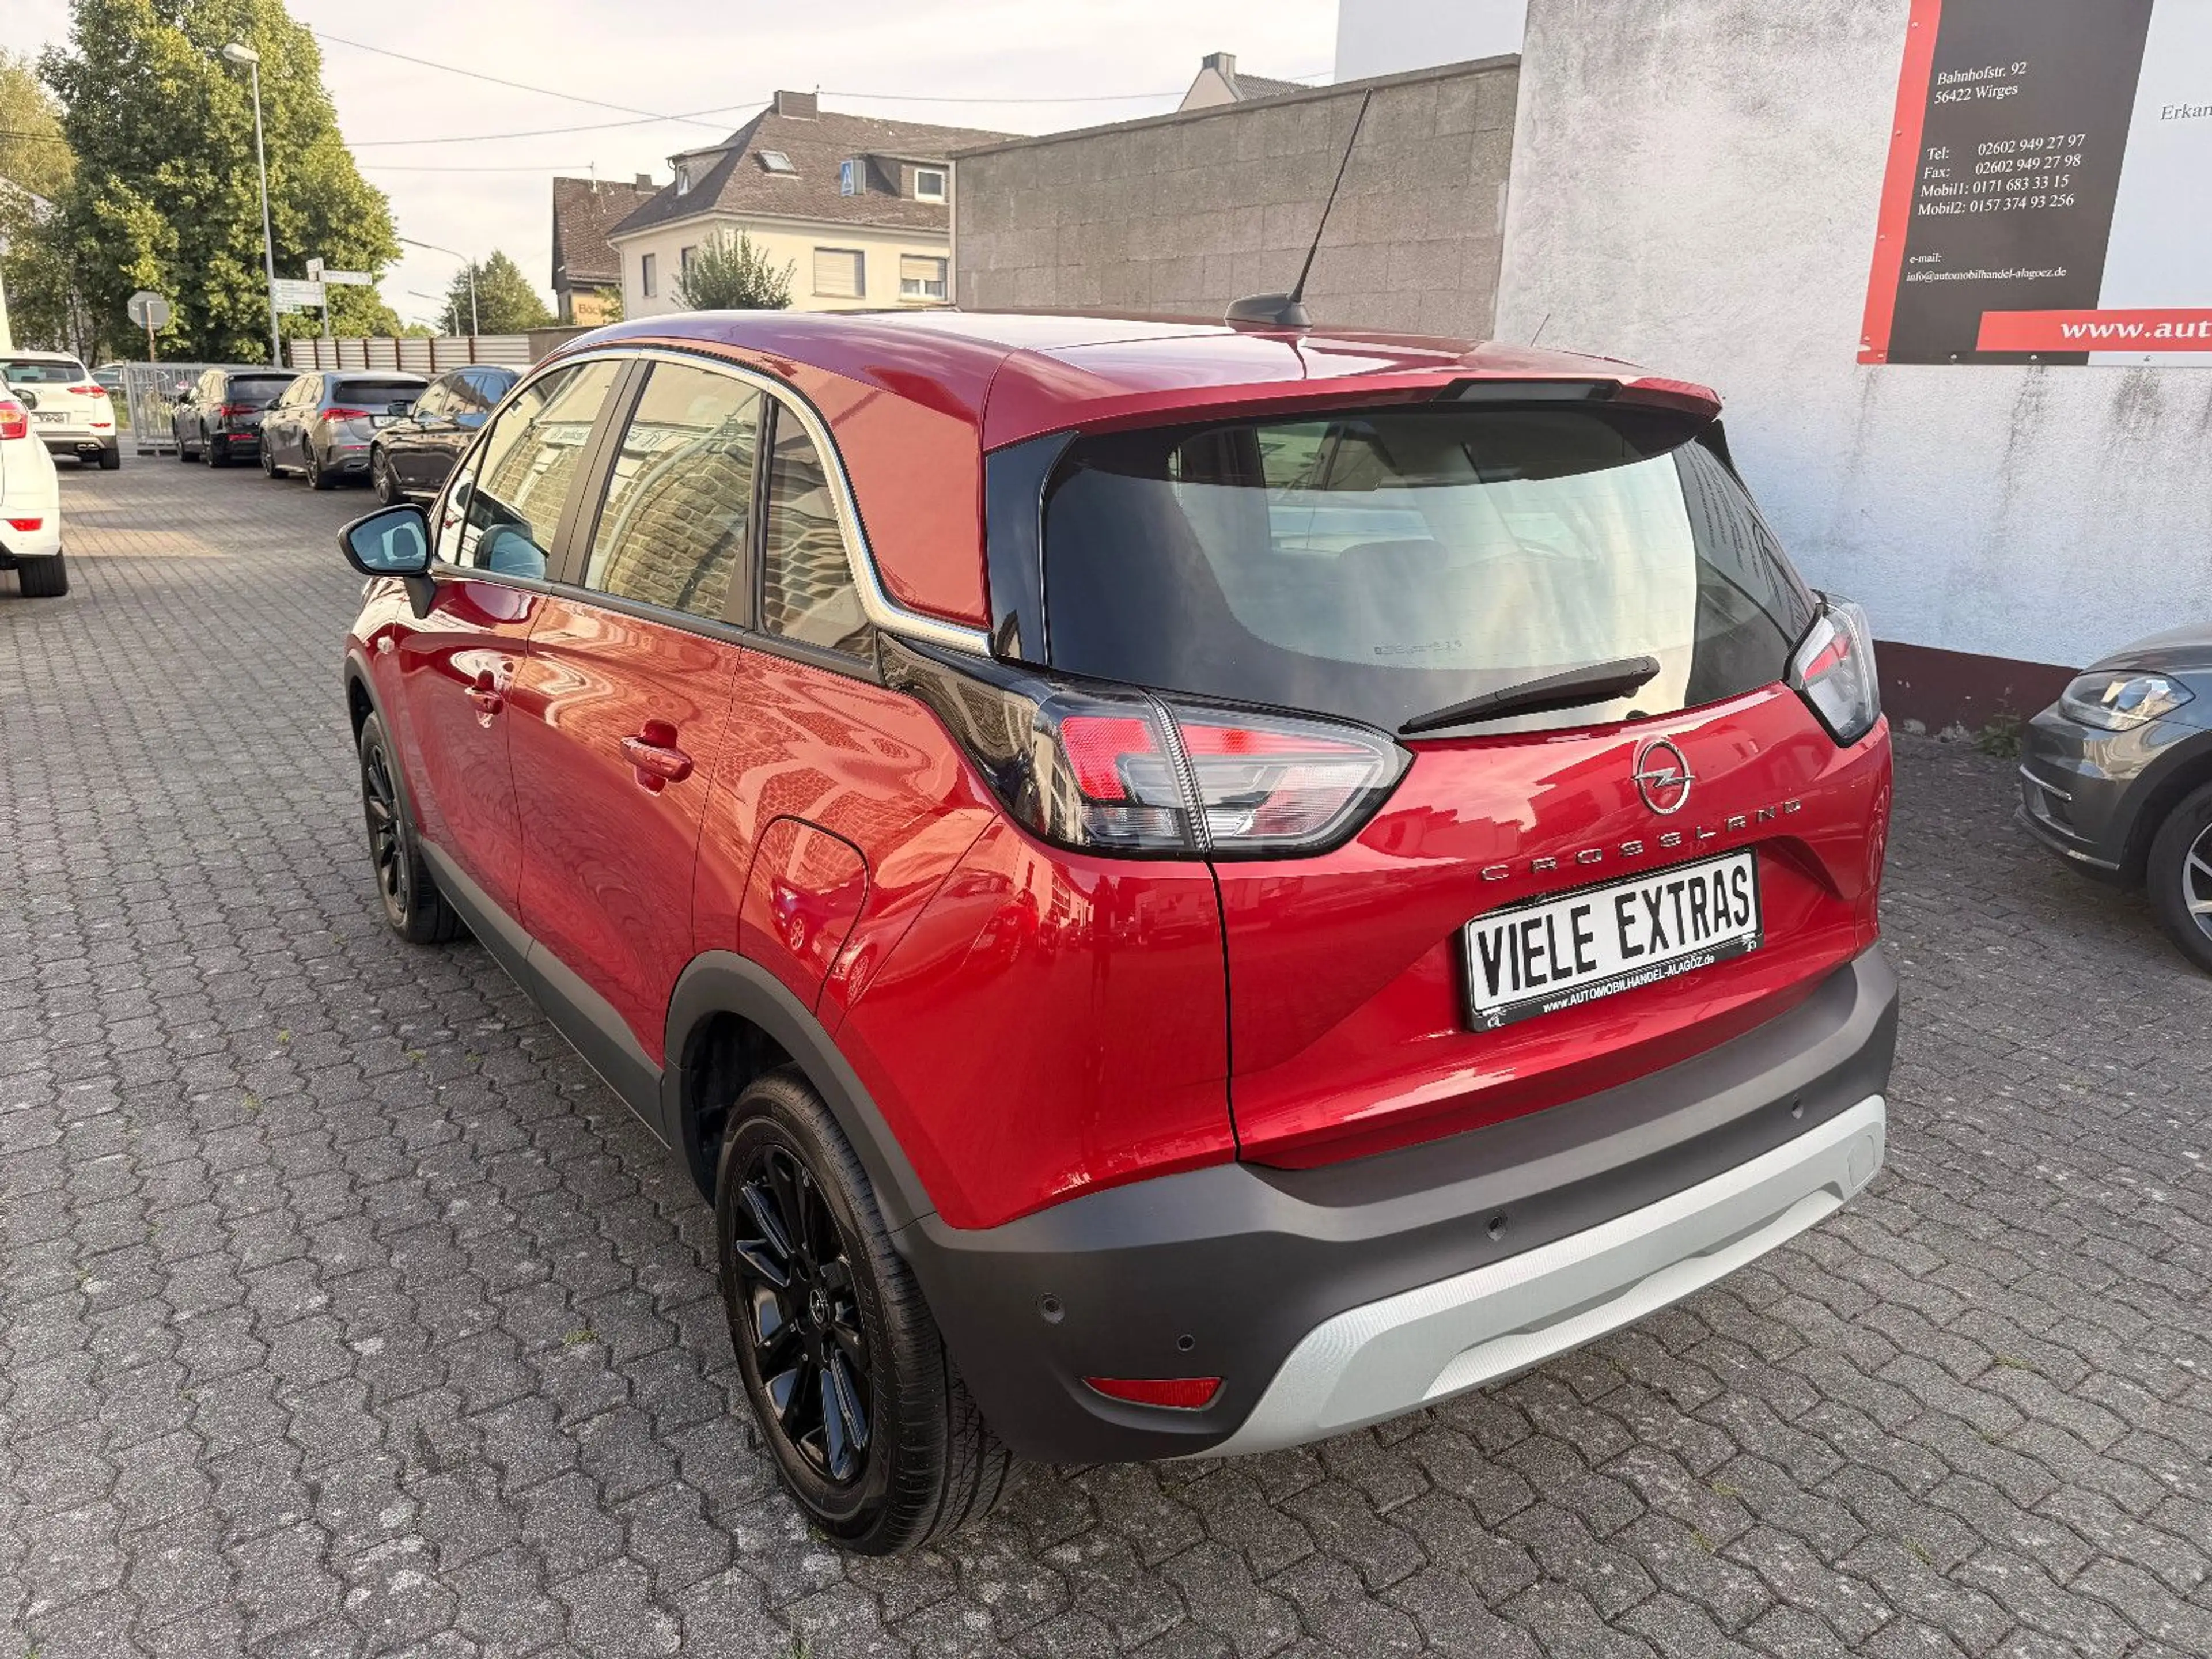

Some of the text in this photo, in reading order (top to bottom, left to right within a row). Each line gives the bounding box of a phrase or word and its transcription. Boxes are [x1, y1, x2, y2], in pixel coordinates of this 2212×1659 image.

[1937, 62, 2027, 85] Bahnhofstr. 92
[1934, 85, 2018, 104] 56422 Wirges
[1927, 133, 2086, 160] Tel: 02602 949 27 97
[1923, 153, 2082, 179] Fax: 02602 949 27 98
[1920, 174, 2070, 197] Mobil1: 0171 683 33 15
[1918, 193, 2075, 216] Mobil2: 0157 374 93 256
[1909, 253, 1942, 264] e-mail:
[2061, 321, 2212, 339] www.aut
[1481, 798, 1801, 881] CROSSLAND
[1478, 865, 1751, 997] VIELE EXTRAS
